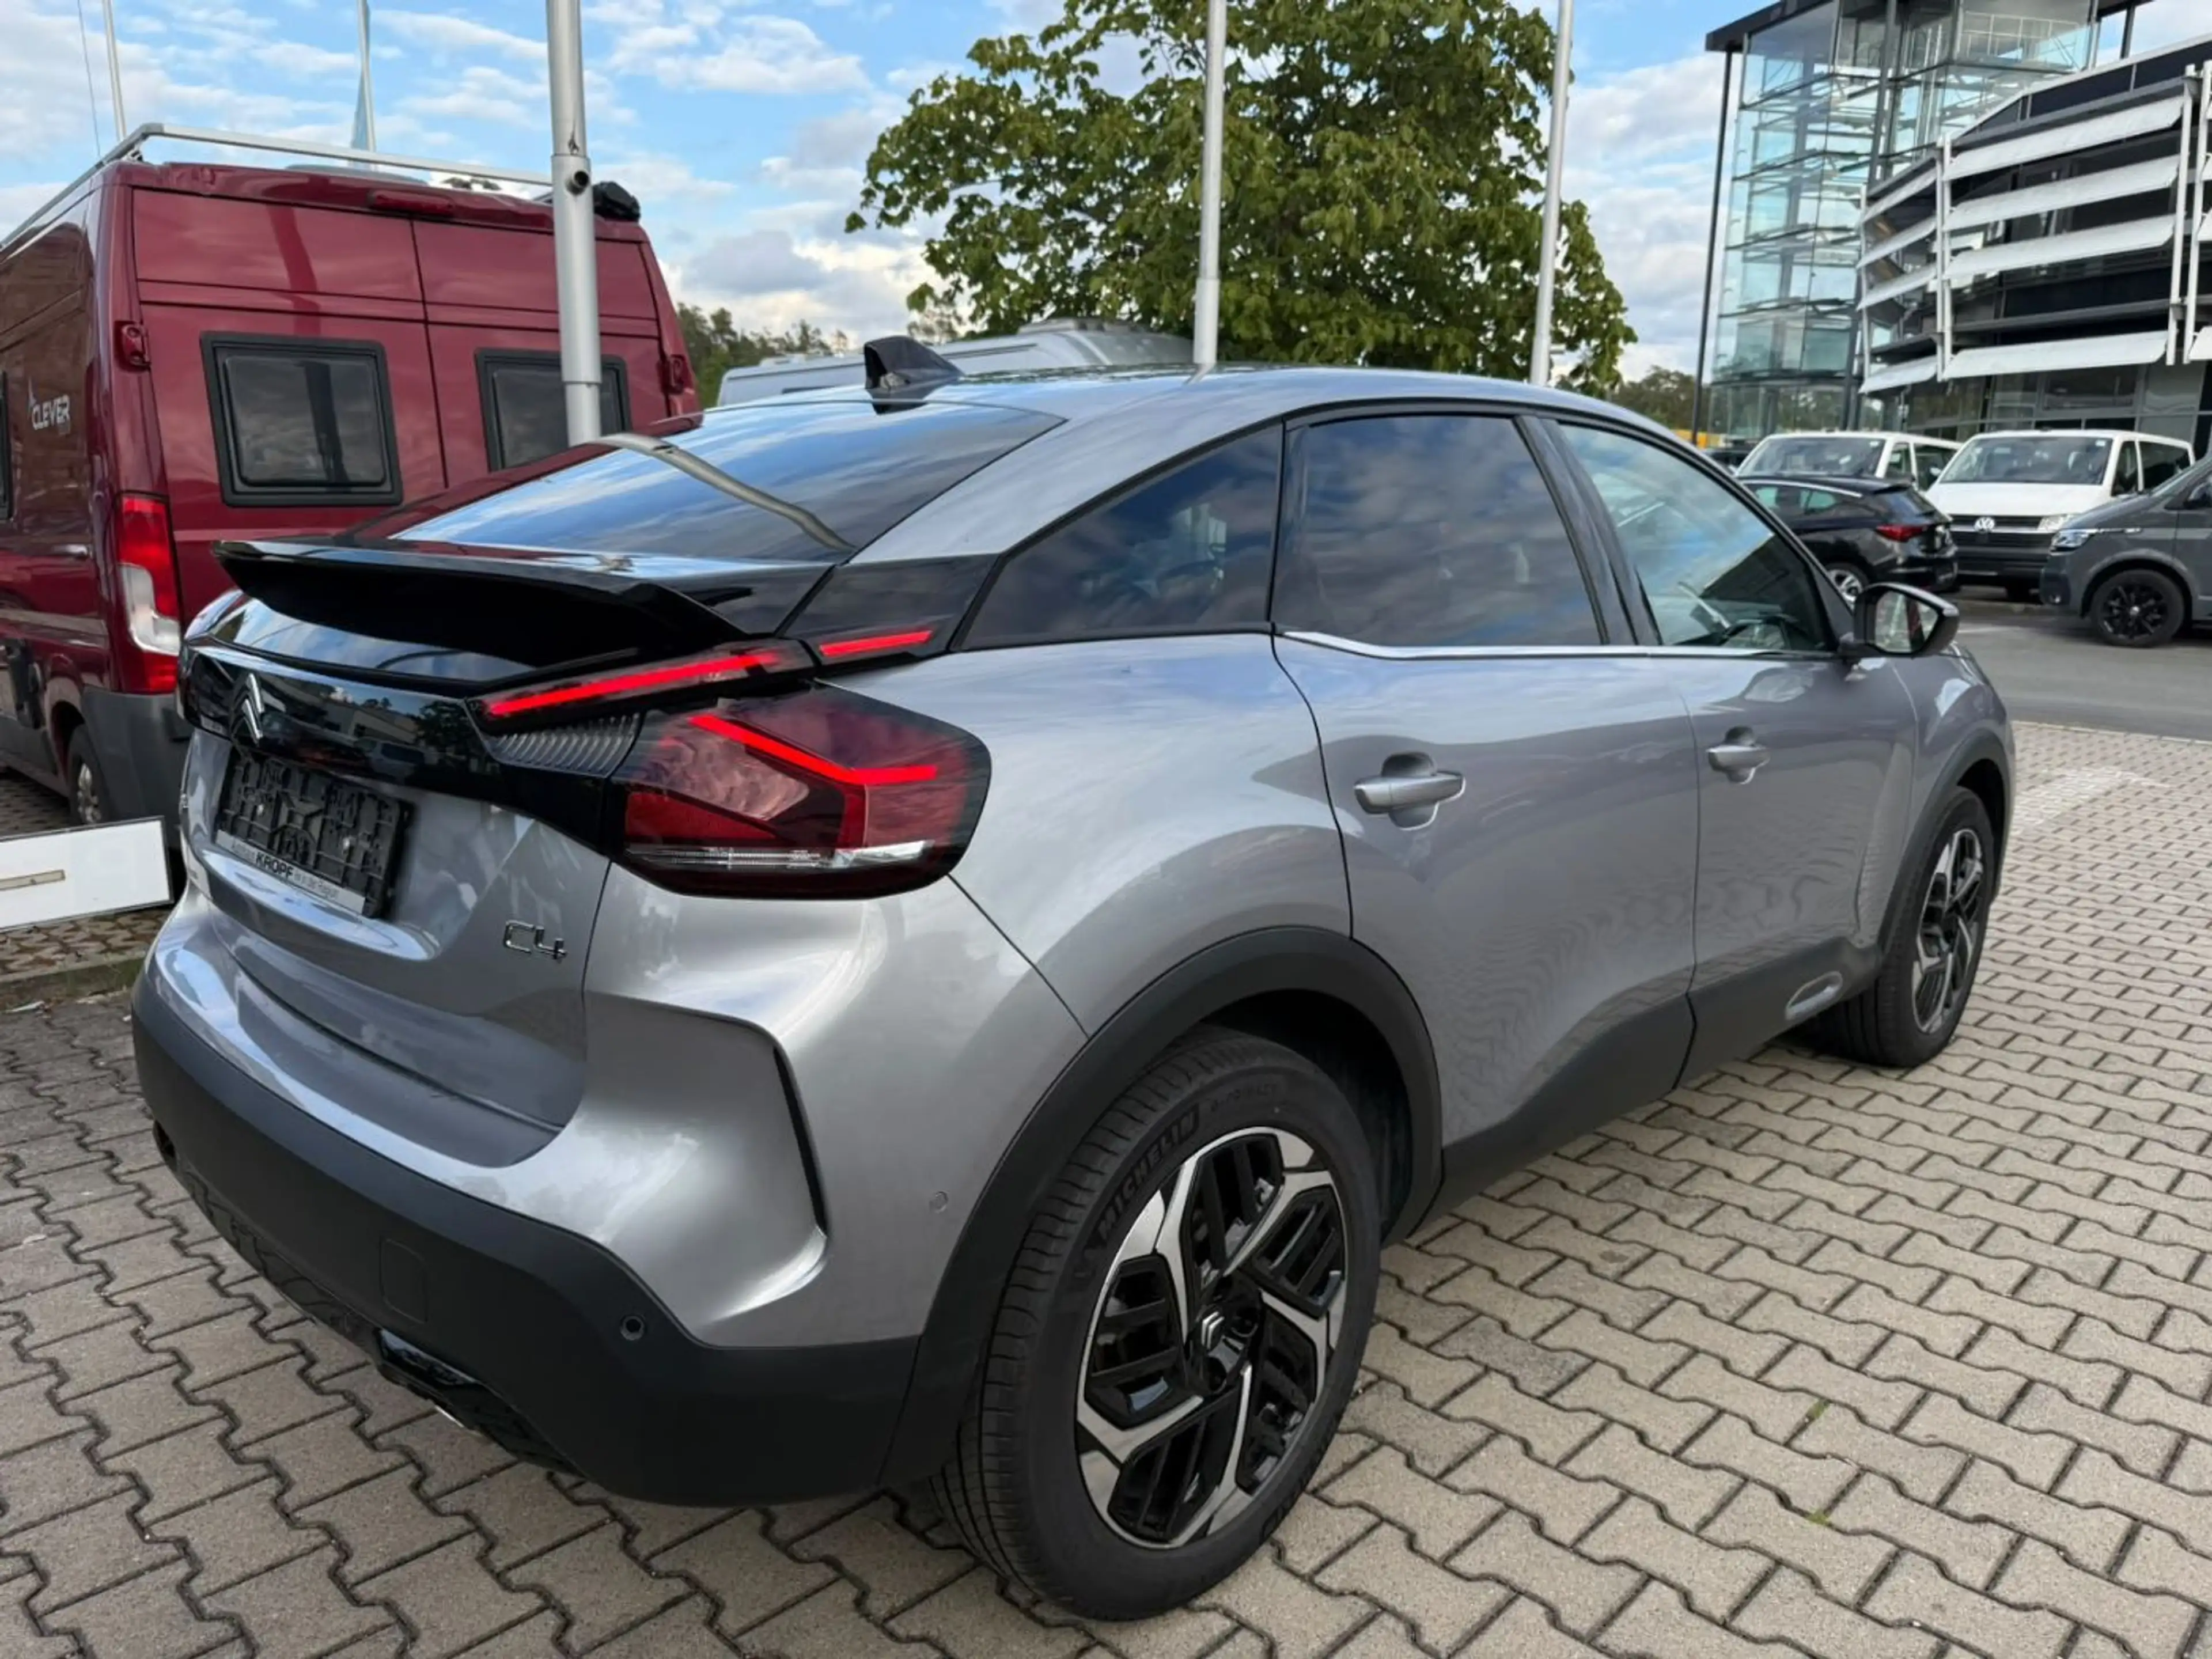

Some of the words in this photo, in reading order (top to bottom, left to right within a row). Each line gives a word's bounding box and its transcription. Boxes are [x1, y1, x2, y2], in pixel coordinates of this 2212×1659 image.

[31, 394, 70, 430] CLEVER
[256, 851, 294, 879] KROPF
[503, 920, 567, 960] C4
[1097, 1109, 1196, 1240] MICHELIN
